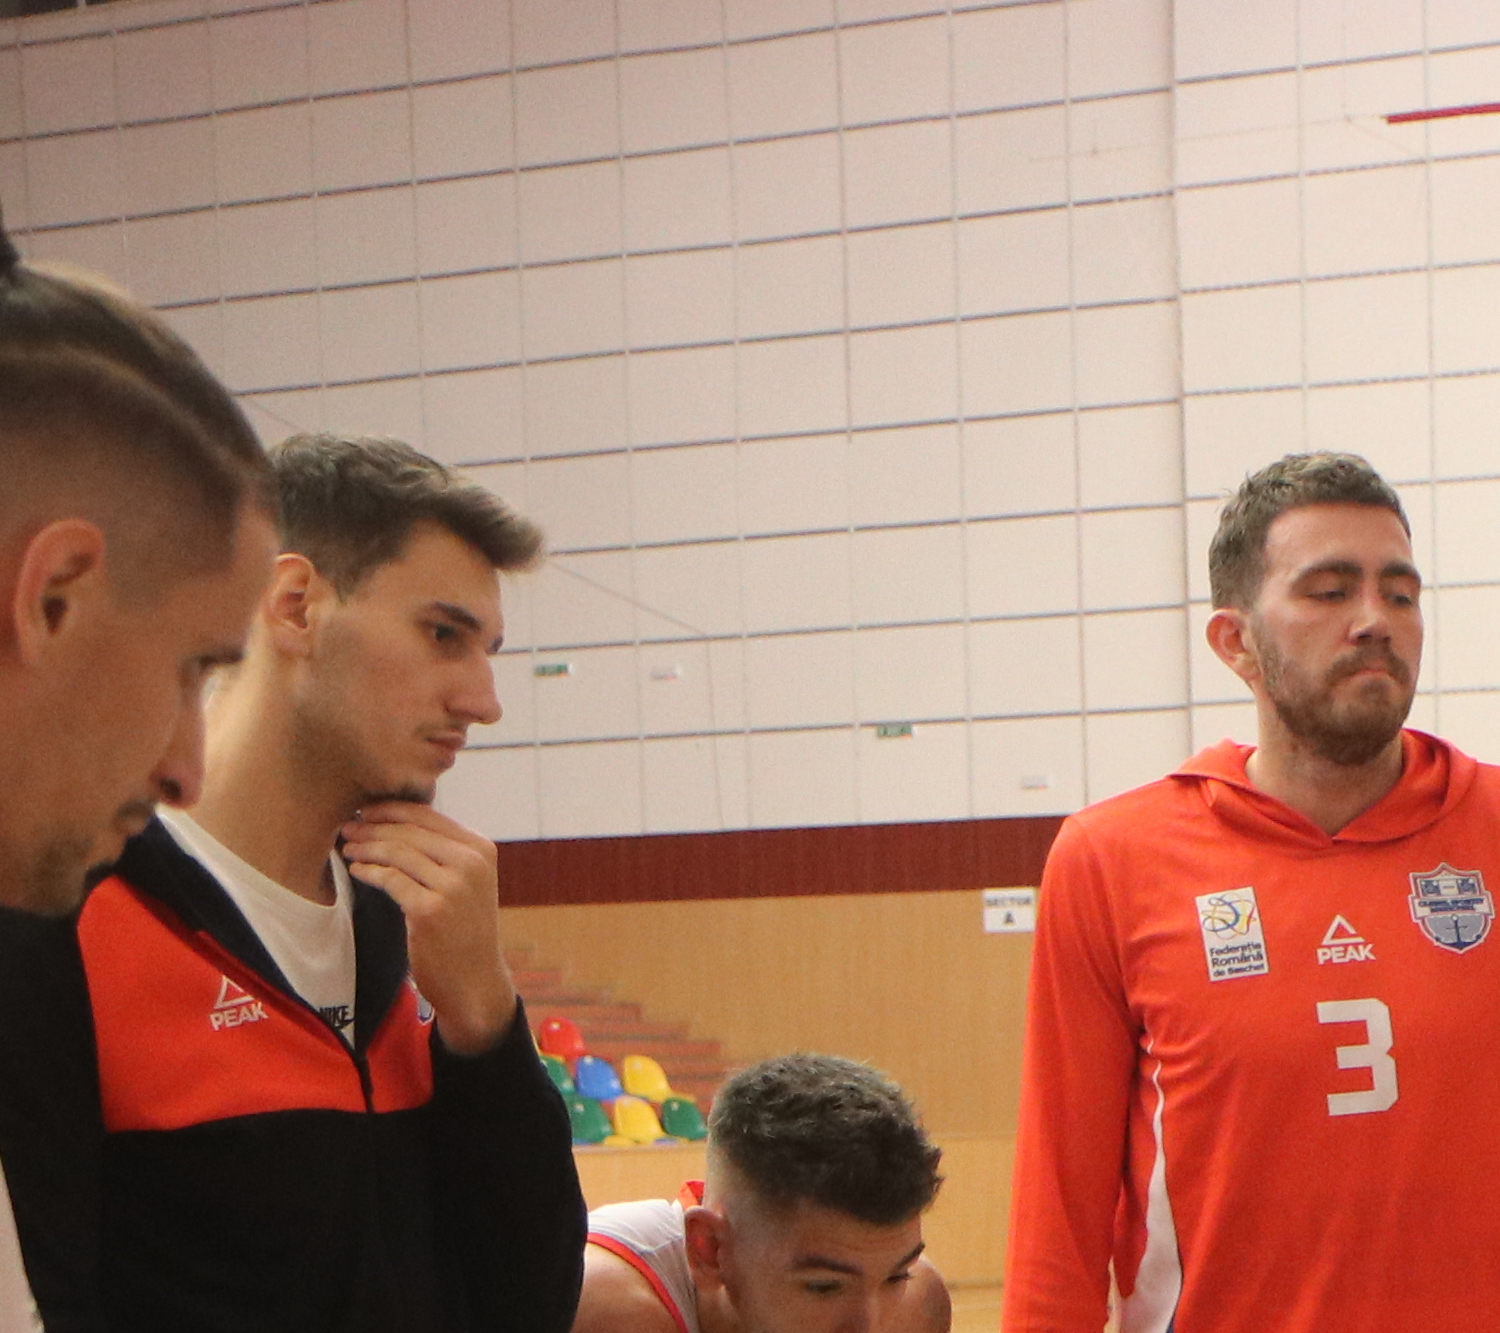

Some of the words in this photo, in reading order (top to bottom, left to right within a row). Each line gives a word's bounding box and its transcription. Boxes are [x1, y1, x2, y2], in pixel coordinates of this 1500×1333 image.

[1316, 943, 1377, 966] PEAK
[209, 1001, 268, 1032] PEAK
[1316, 998, 1399, 1116] 3
